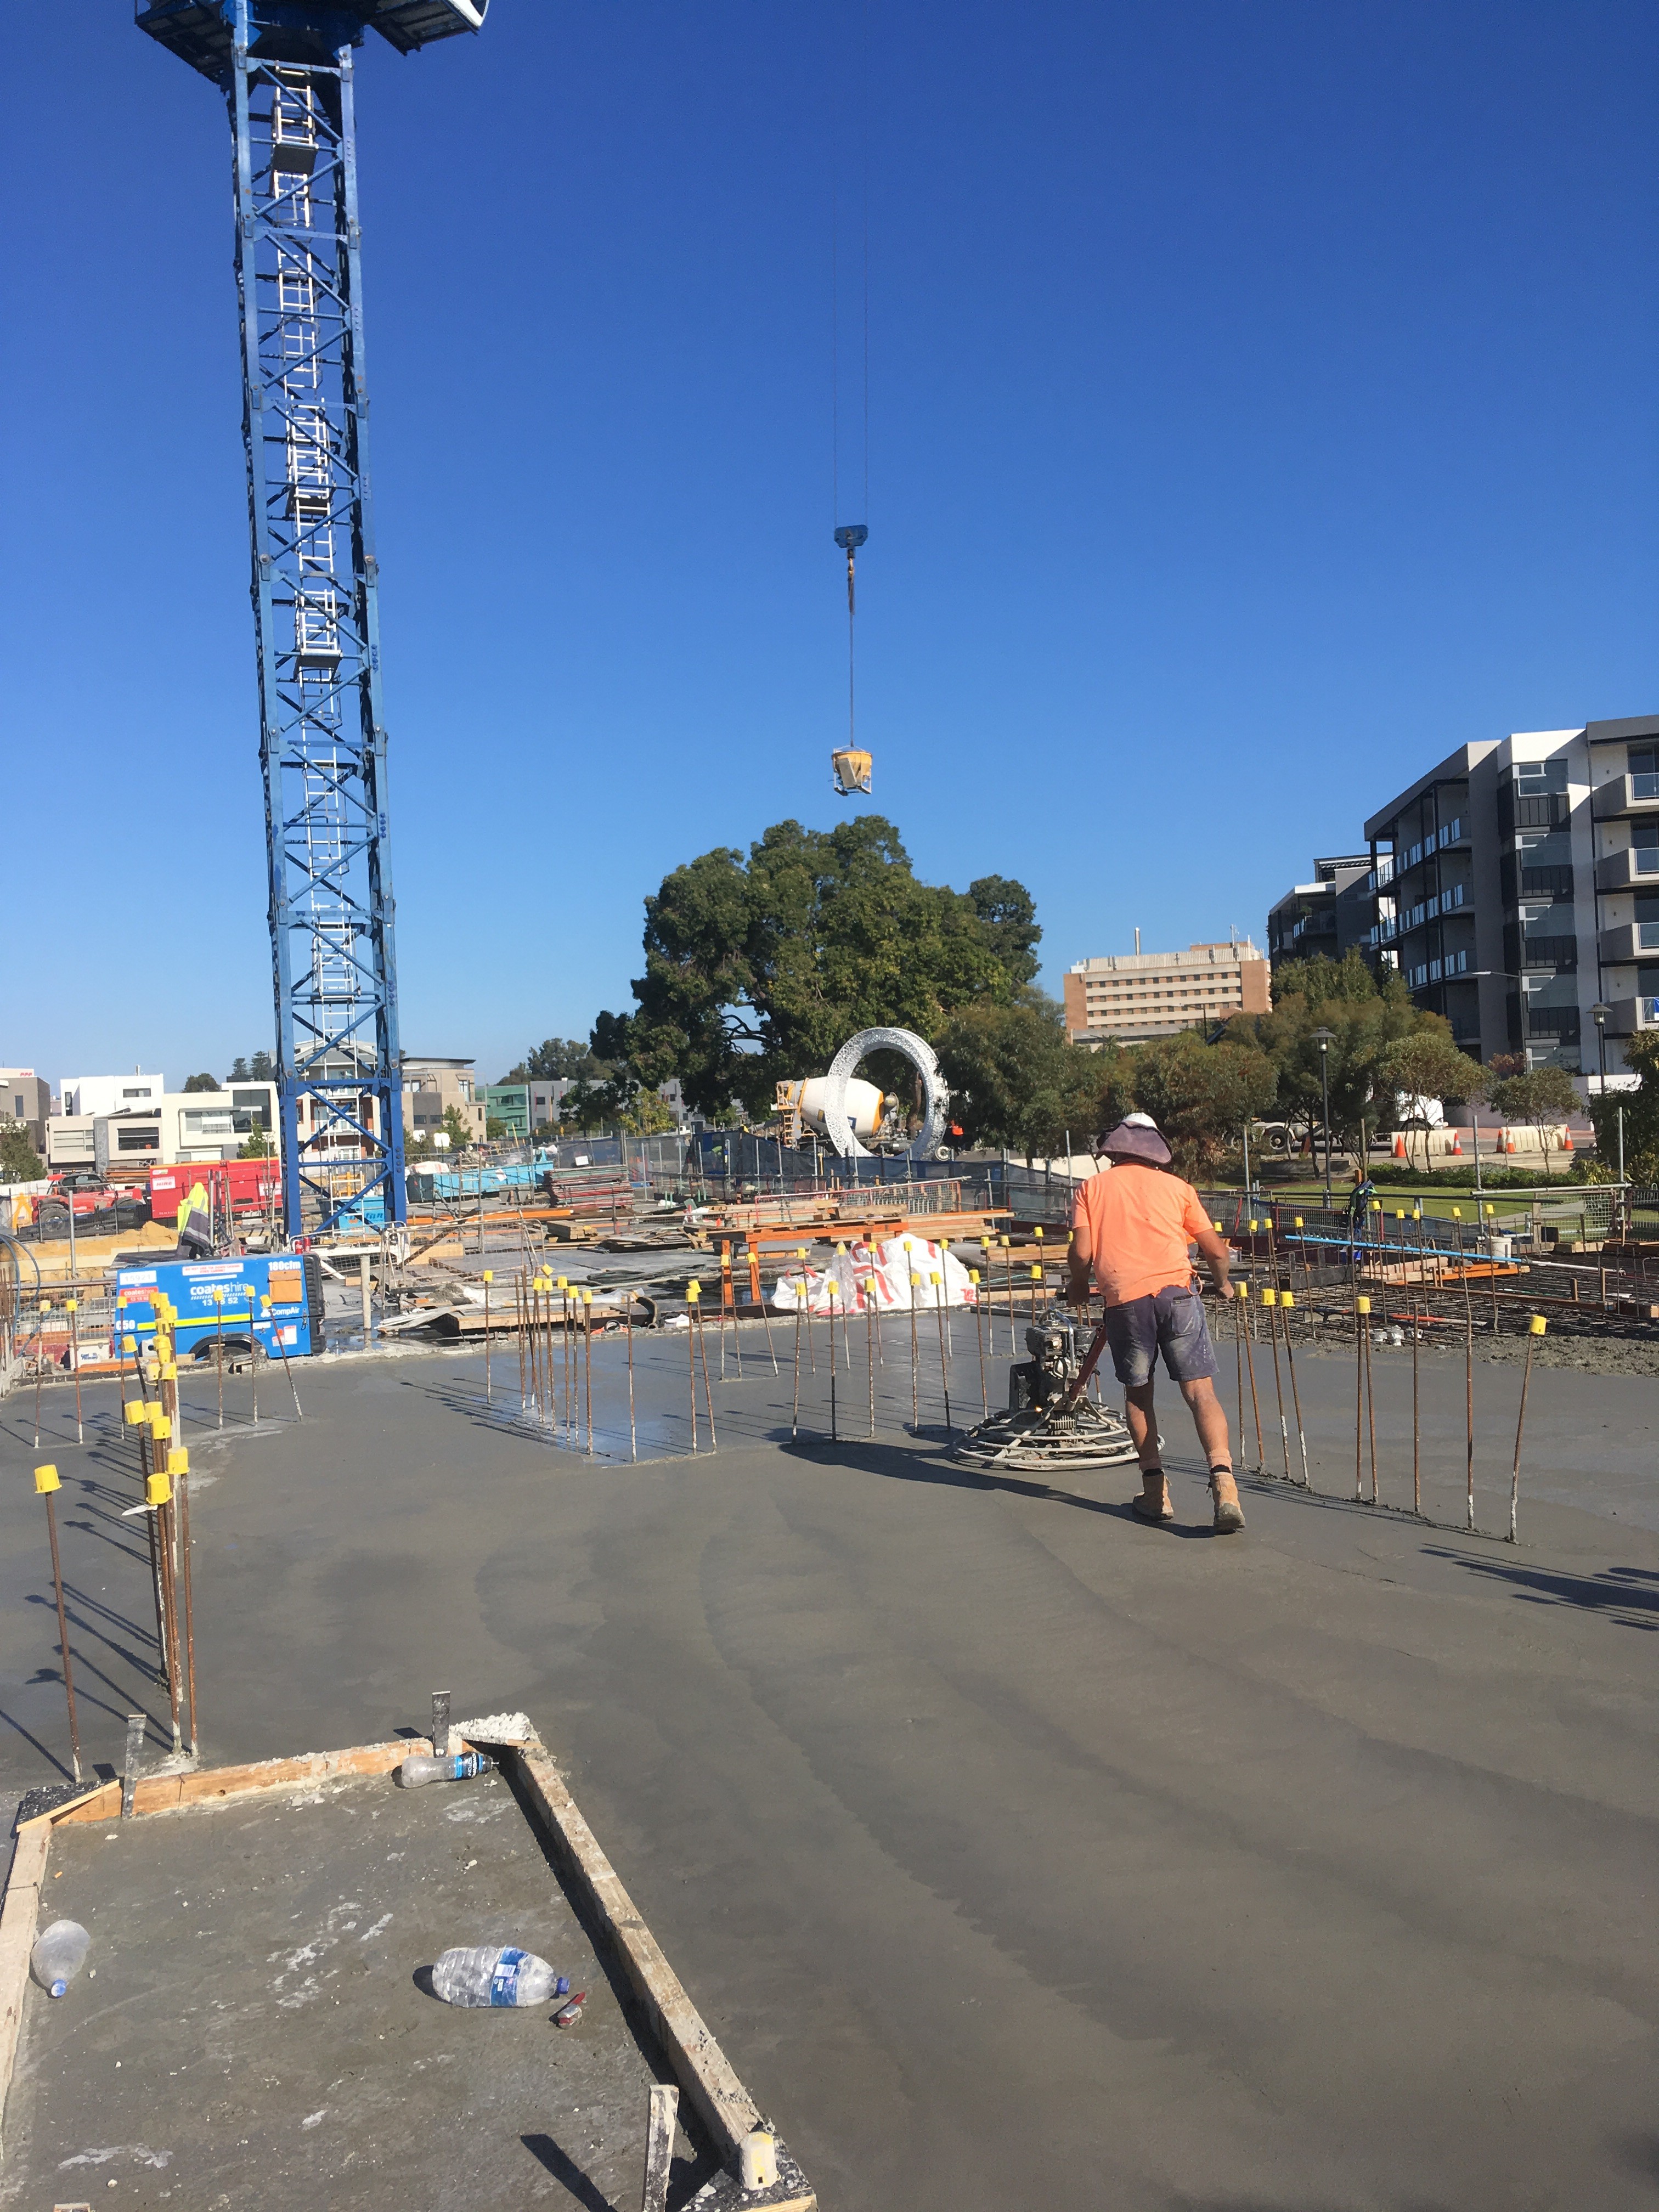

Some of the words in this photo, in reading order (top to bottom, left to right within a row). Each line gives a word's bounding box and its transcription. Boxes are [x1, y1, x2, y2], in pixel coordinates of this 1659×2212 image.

[268, 1261, 301, 1271] 180cfm
[125, 1274, 151, 1282] 15921
[272, 1306, 300, 1316] CompAir
